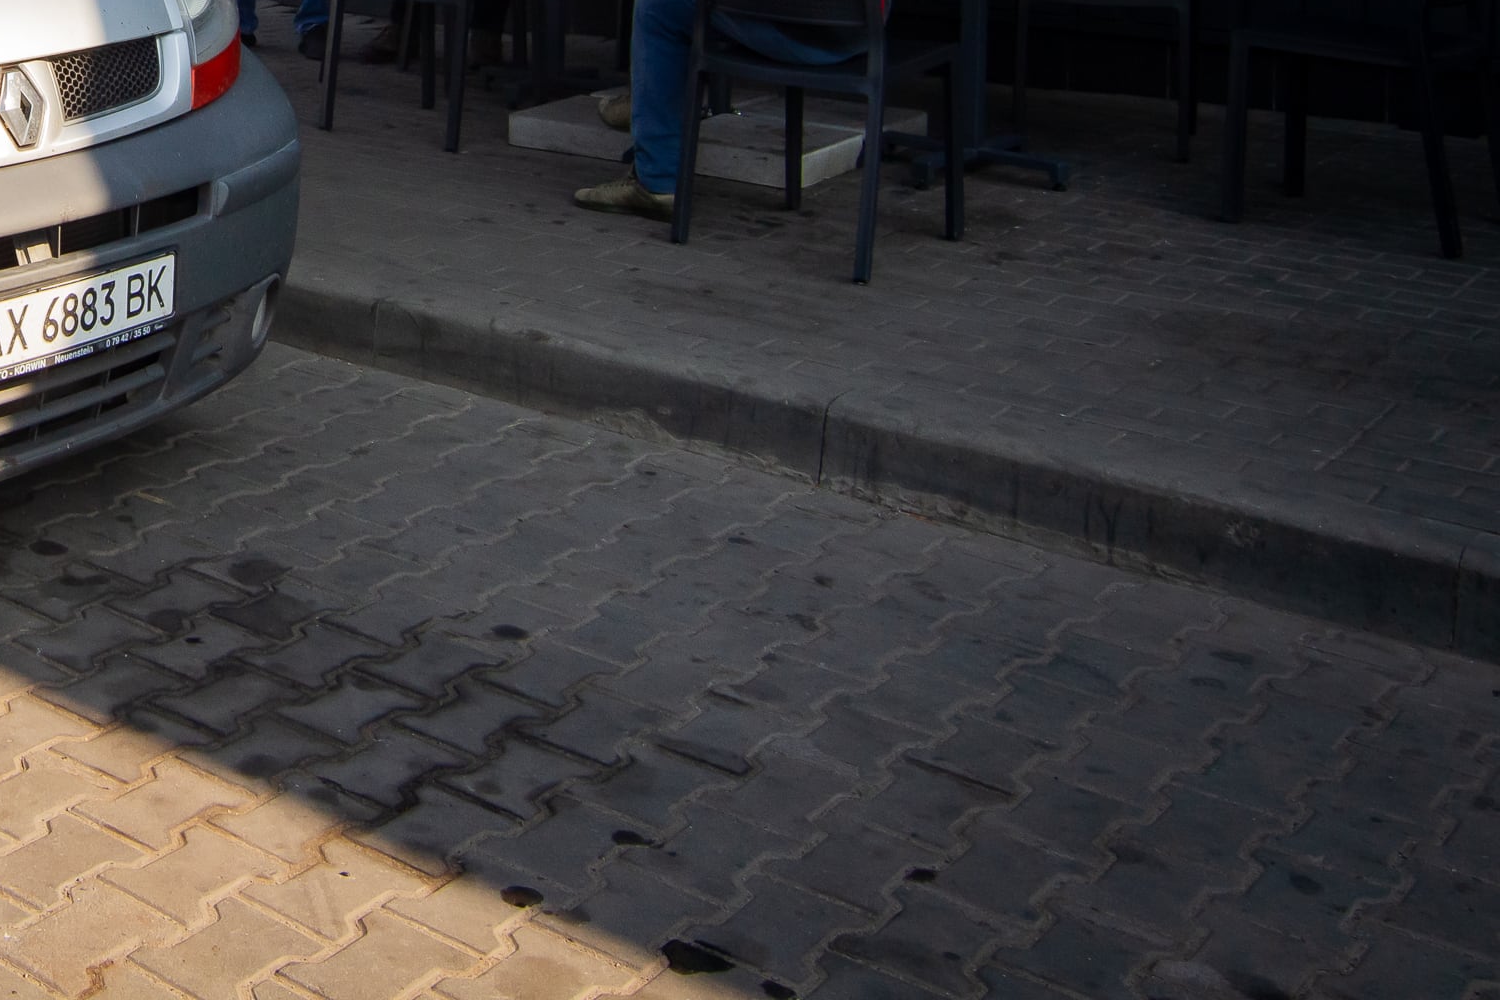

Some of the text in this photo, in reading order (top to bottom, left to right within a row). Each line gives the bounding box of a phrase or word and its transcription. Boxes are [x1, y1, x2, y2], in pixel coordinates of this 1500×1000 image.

[42, 280, 116, 344] 6883
[126, 265, 166, 319] BK
[14, 358, 47, 376] KORWIN
[54, 345, 94, 364] Neuenstein
